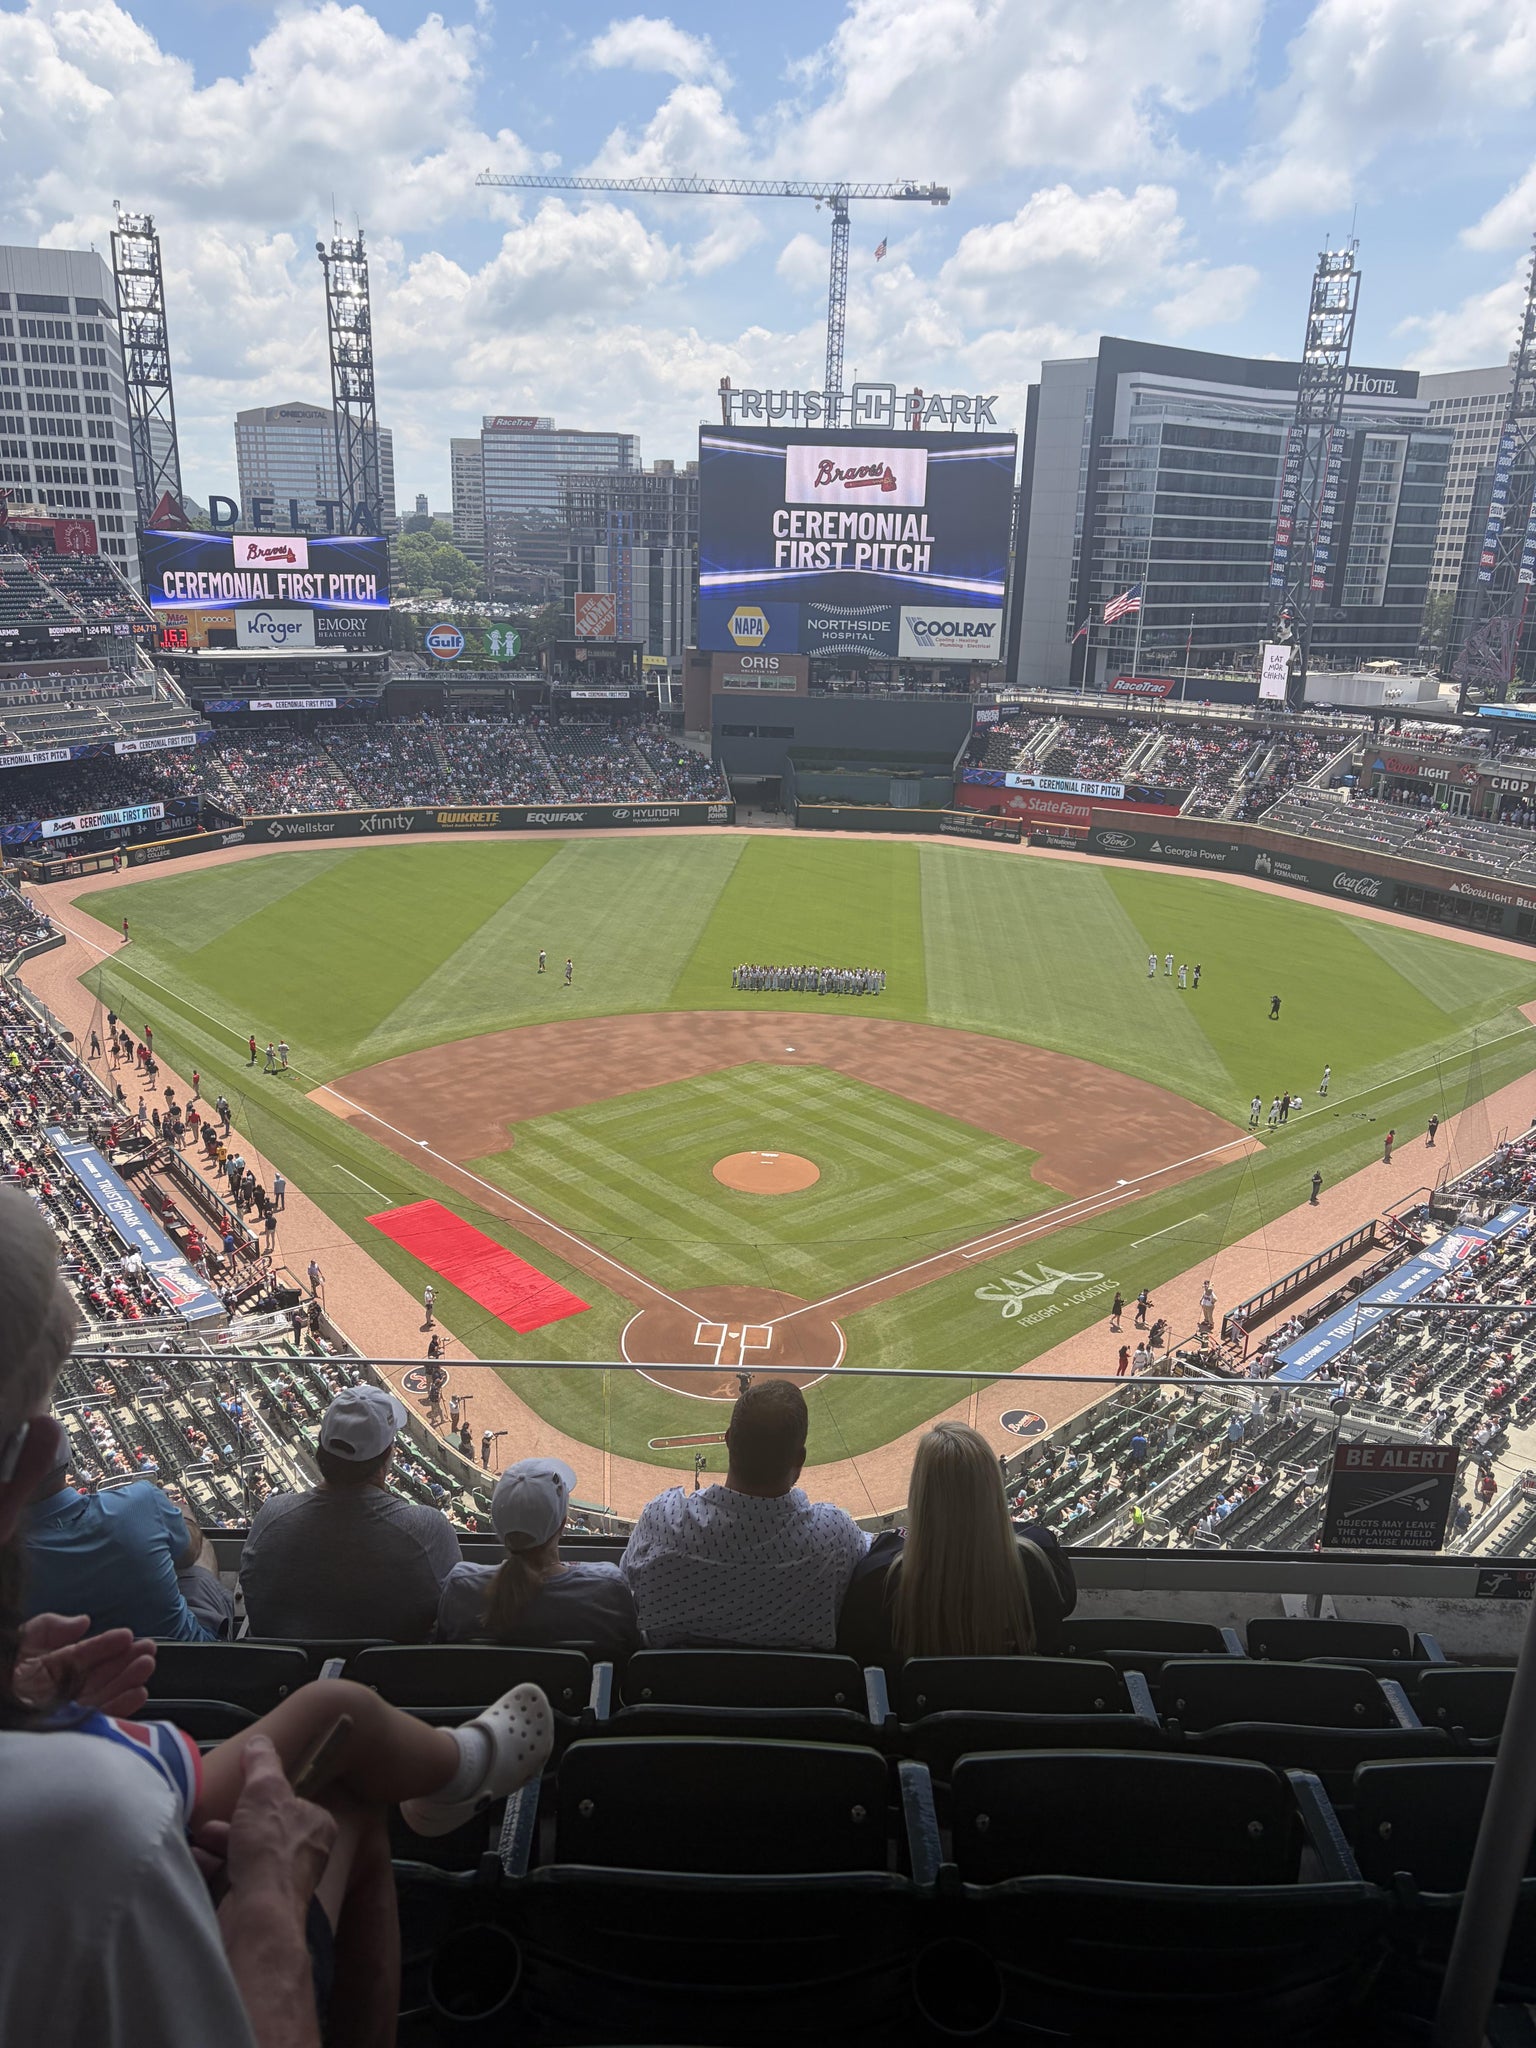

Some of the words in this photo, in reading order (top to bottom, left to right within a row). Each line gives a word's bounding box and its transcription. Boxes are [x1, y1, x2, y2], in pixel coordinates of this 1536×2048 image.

[1352, 373, 1399, 395] HOTEL
[718, 389, 844, 420] TRUIST
[905, 394, 999, 425] PARK
[496, 418, 533, 427] RaceTrac
[815, 459, 884, 488] Braves
[208, 495, 379, 535] DELTA
[773, 509, 935, 542] CEREMONIAL
[247, 543, 288, 560] Braves
[775, 541, 848, 569] FIRST
[855, 543, 930, 572] PITCH
[163, 571, 276, 599] CEREMONIAL
[277, 573, 324, 600] FIRST
[329, 575, 377, 600] PITCH
[580, 598, 596, 615] THE
[576, 594, 613, 636] HOME
[592, 610, 615, 635] DEPOT
[86, 626, 100, 634] 1:24
[100, 626, 112, 634] PM
[248, 612, 302, 643] Kroger
[318, 618, 368, 630] EMORY
[735, 617, 763, 636] NAPA
[808, 619, 891, 632] NORTHSIDE
[914, 621, 997, 637] COOLRAY
[163, 629, 187, 642] 163
[428, 635, 462, 648] Gulf
[822, 632, 875, 640] HOSPITAL
[740, 656, 780, 669] ORIS
[1270, 655, 1284, 663] EAT
[1268, 663, 1284, 672] MOR
[1263, 671, 1286, 681] CHIKIN
[1114, 680, 1165, 693] RaceTrac
[275, 700, 304, 708] CEREMONIAL
[305, 700, 319, 708] FIRST
[320, 699, 334, 707] PITCH
[139, 739, 167, 749] CEREMONIAL
[167, 737, 180, 746] FIRST
[180, 735, 194, 744] PITCH
[33, 753, 49, 762] FIRST
[50, 750, 67, 760] PITCH
[1386, 758, 1418, 774] Coors
[1418, 767, 1450, 780] LIGHT
[1039, 780, 1079, 793] CEREMONIAL
[1080, 784, 1099, 795] FIRST
[1100, 786, 1121, 797] PITCH
[1491, 777, 1529, 792] CHOP
[633, 808, 680, 817] HYUNDAI
[708, 805, 727, 813] PAPA
[80, 813, 122, 829] CEREMONIAL
[122, 809, 141, 824] FIRST
[142, 806, 161, 820] PITCH
[360, 814, 415, 832] xfinity
[437, 812, 499, 823] QUIKRETE
[526, 812, 584, 825] EQUIFAX
[286, 822, 335, 834] Wellstar
[1102, 834, 1129, 847] Ford
[147, 849, 171, 859] COLLEGE
[1165, 845, 1197, 858] Georgia
[1199, 850, 1226, 861] Power
[1274, 861, 1292, 870] KAISER
[1333, 872, 1383, 898] Coca-Cola
[1461, 883, 1487, 898] Coors
[1487, 892, 1512, 904] LIGHT
[97, 1179, 124, 1204] TRUIST
[118, 1206, 143, 1228] PARK
[974, 1261, 1092, 1318] SAIA
[1016, 1304, 1062, 1328] FREIGHT
[1067, 1279, 1120, 1305] LOGISTICS
[1294, 1345, 1323, 1366] WELCOME
[1322, 1339, 1331, 1348] TO
[1327, 1307, 1365, 1339] TRUIST
[1346, 1449, 1376, 1466] BE
[1381, 1450, 1449, 1468] ALERT
[1336, 1520, 1379, 1528] OBJECTS
[1382, 1520, 1403, 1528] MAY
[1406, 1521, 1438, 1529] LEAVE
[1338, 1528, 1357, 1536] THE
[1360, 1528, 1401, 1537] PLAYING
[1404, 1530, 1432, 1538] FIELD
[1341, 1537, 1359, 1545] MAY
[1362, 1538, 1398, 1546] CAUSE
[1400, 1539, 1436, 1547] INJURY
